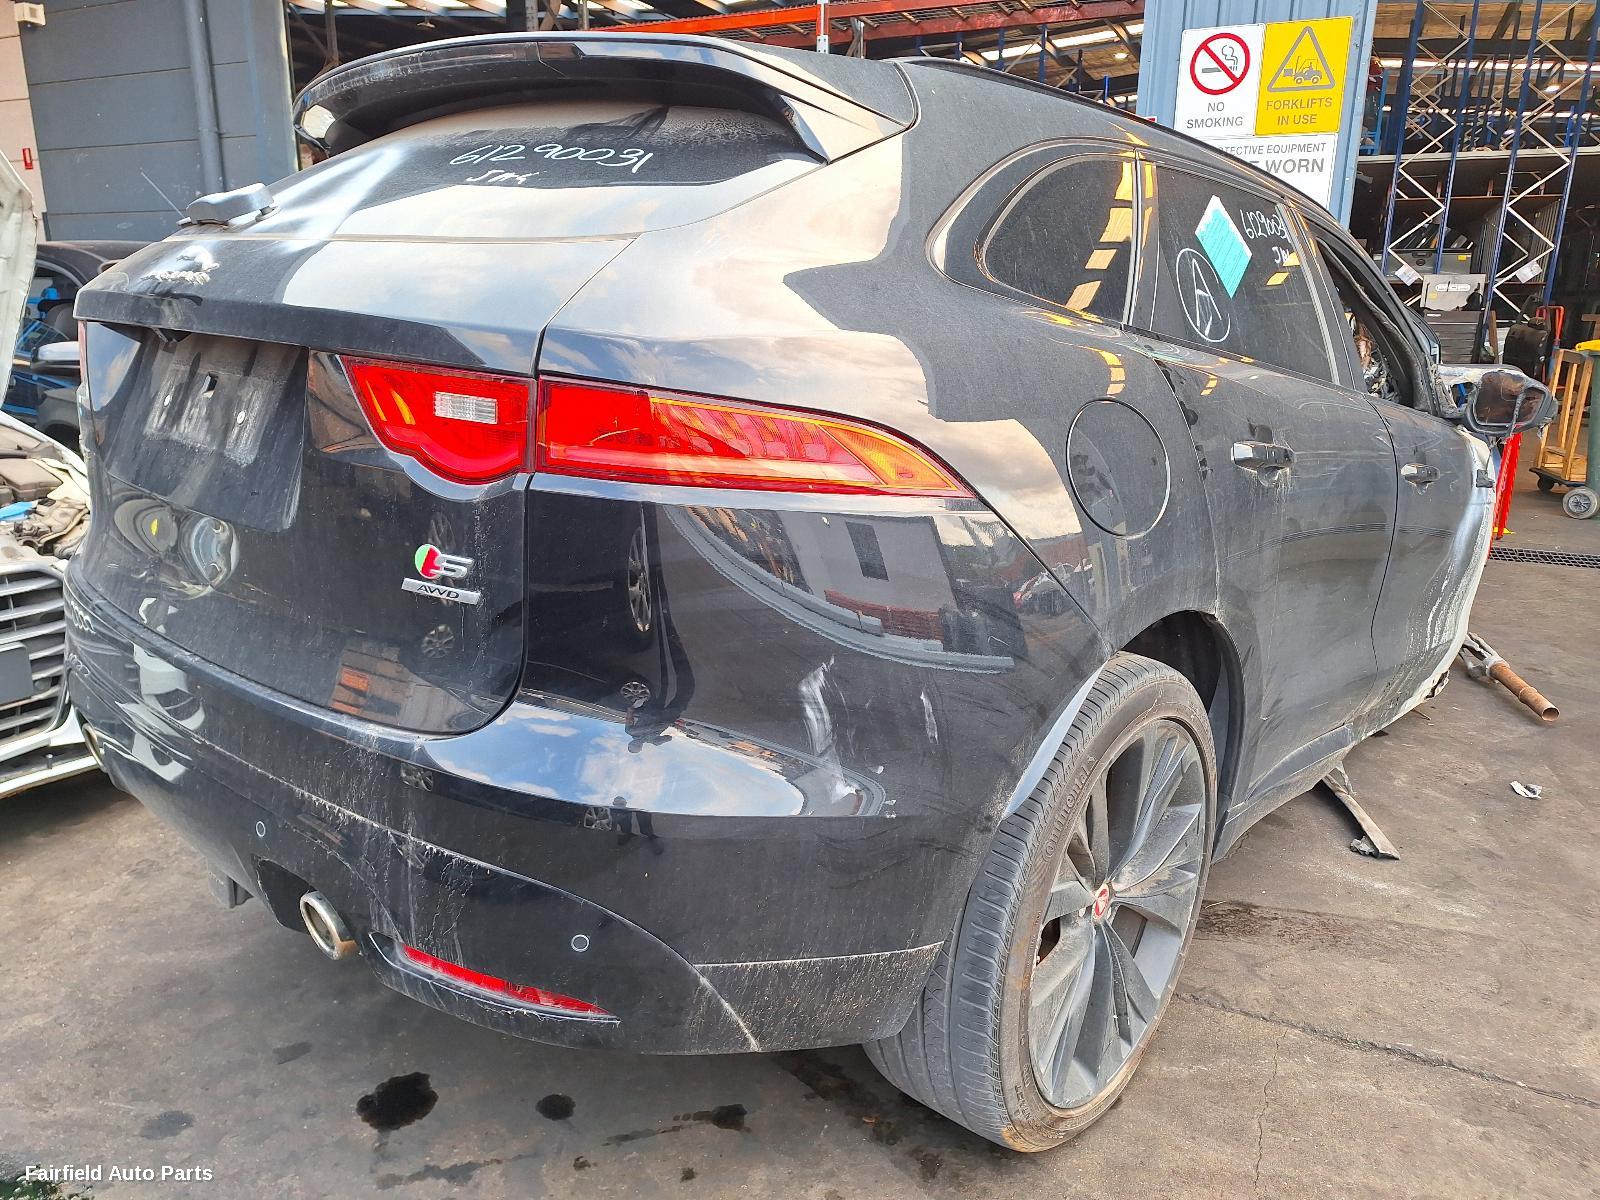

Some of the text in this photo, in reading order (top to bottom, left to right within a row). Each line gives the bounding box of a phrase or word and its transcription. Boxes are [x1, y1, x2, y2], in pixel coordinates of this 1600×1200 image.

[1207, 102, 1225, 112] NO
[1266, 97, 1333, 110] FORKLIFTS
[1186, 116, 1243, 129] SMOKING
[1277, 113, 1317, 126] IN USE
[1266, 142, 1327, 154] EQUIPMENT
[1265, 158, 1325, 174] WORN
[417, 584, 460, 599] AWD
